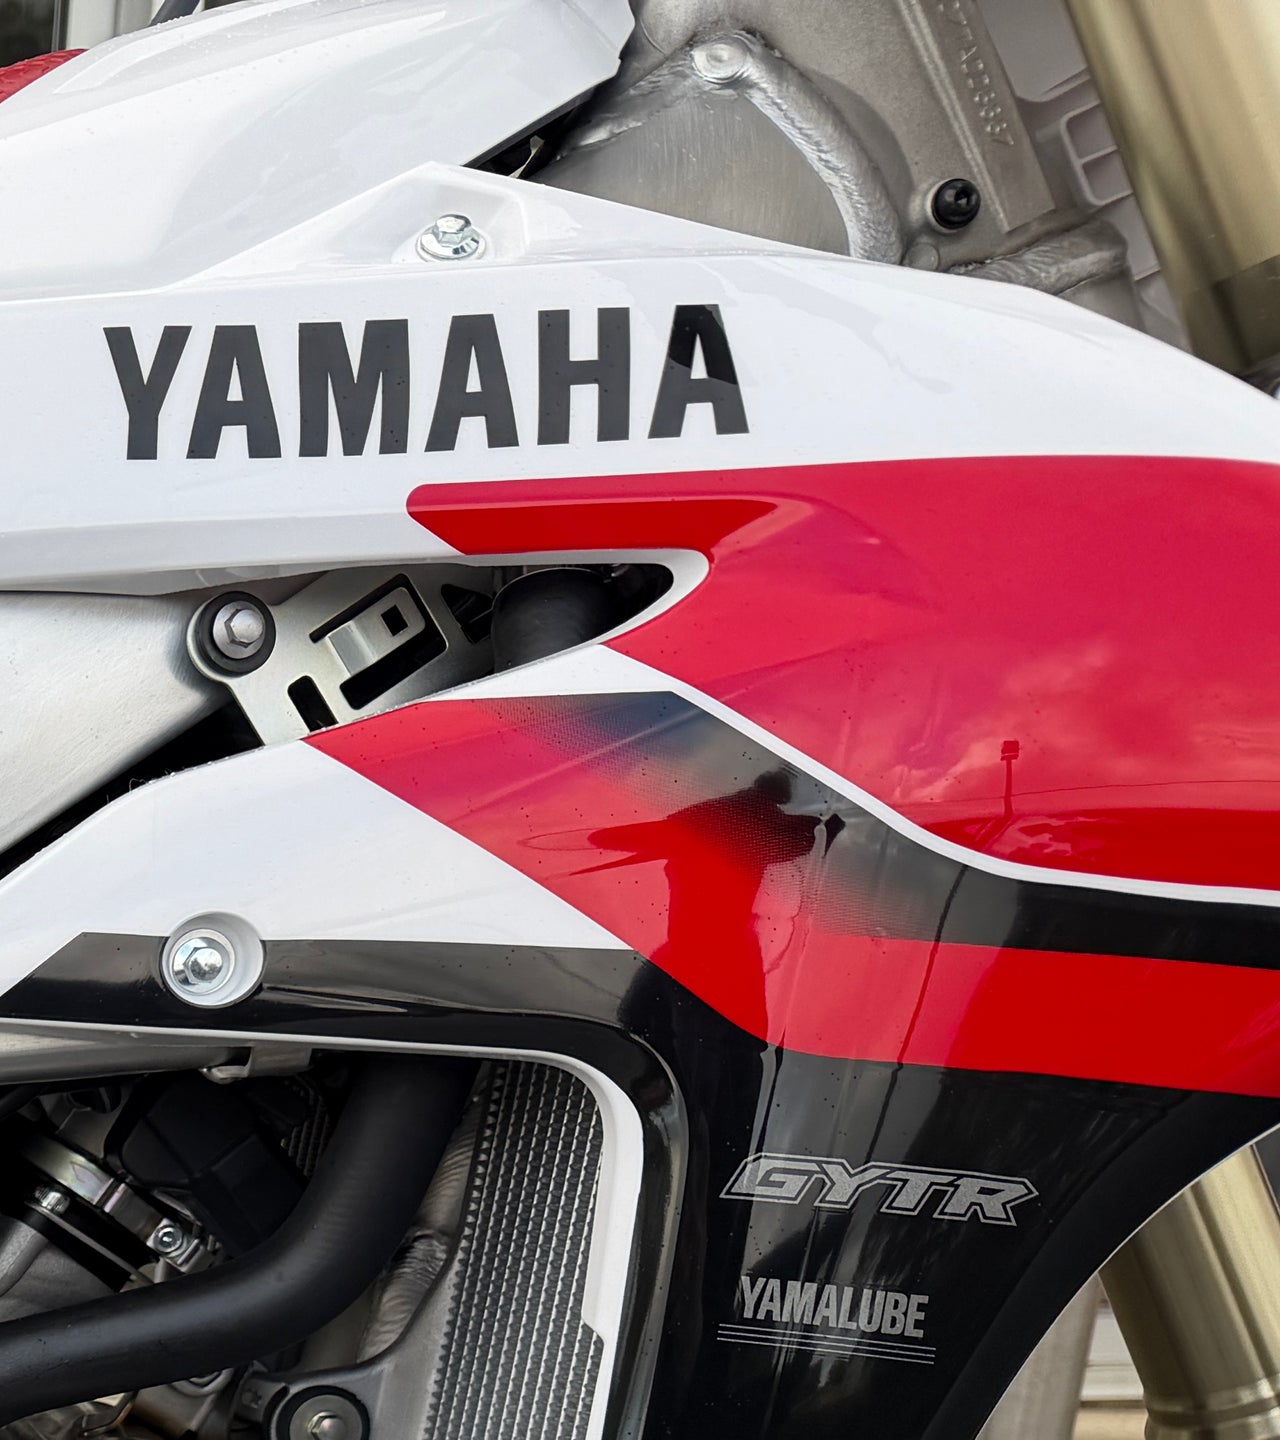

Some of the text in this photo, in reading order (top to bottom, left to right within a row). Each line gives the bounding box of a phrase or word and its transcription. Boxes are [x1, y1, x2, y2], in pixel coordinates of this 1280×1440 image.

[103, 303, 750, 460] YAMAHA
[718, 1152, 1039, 1226] GYTR
[740, 1275, 930, 1338] YAMALUBE
